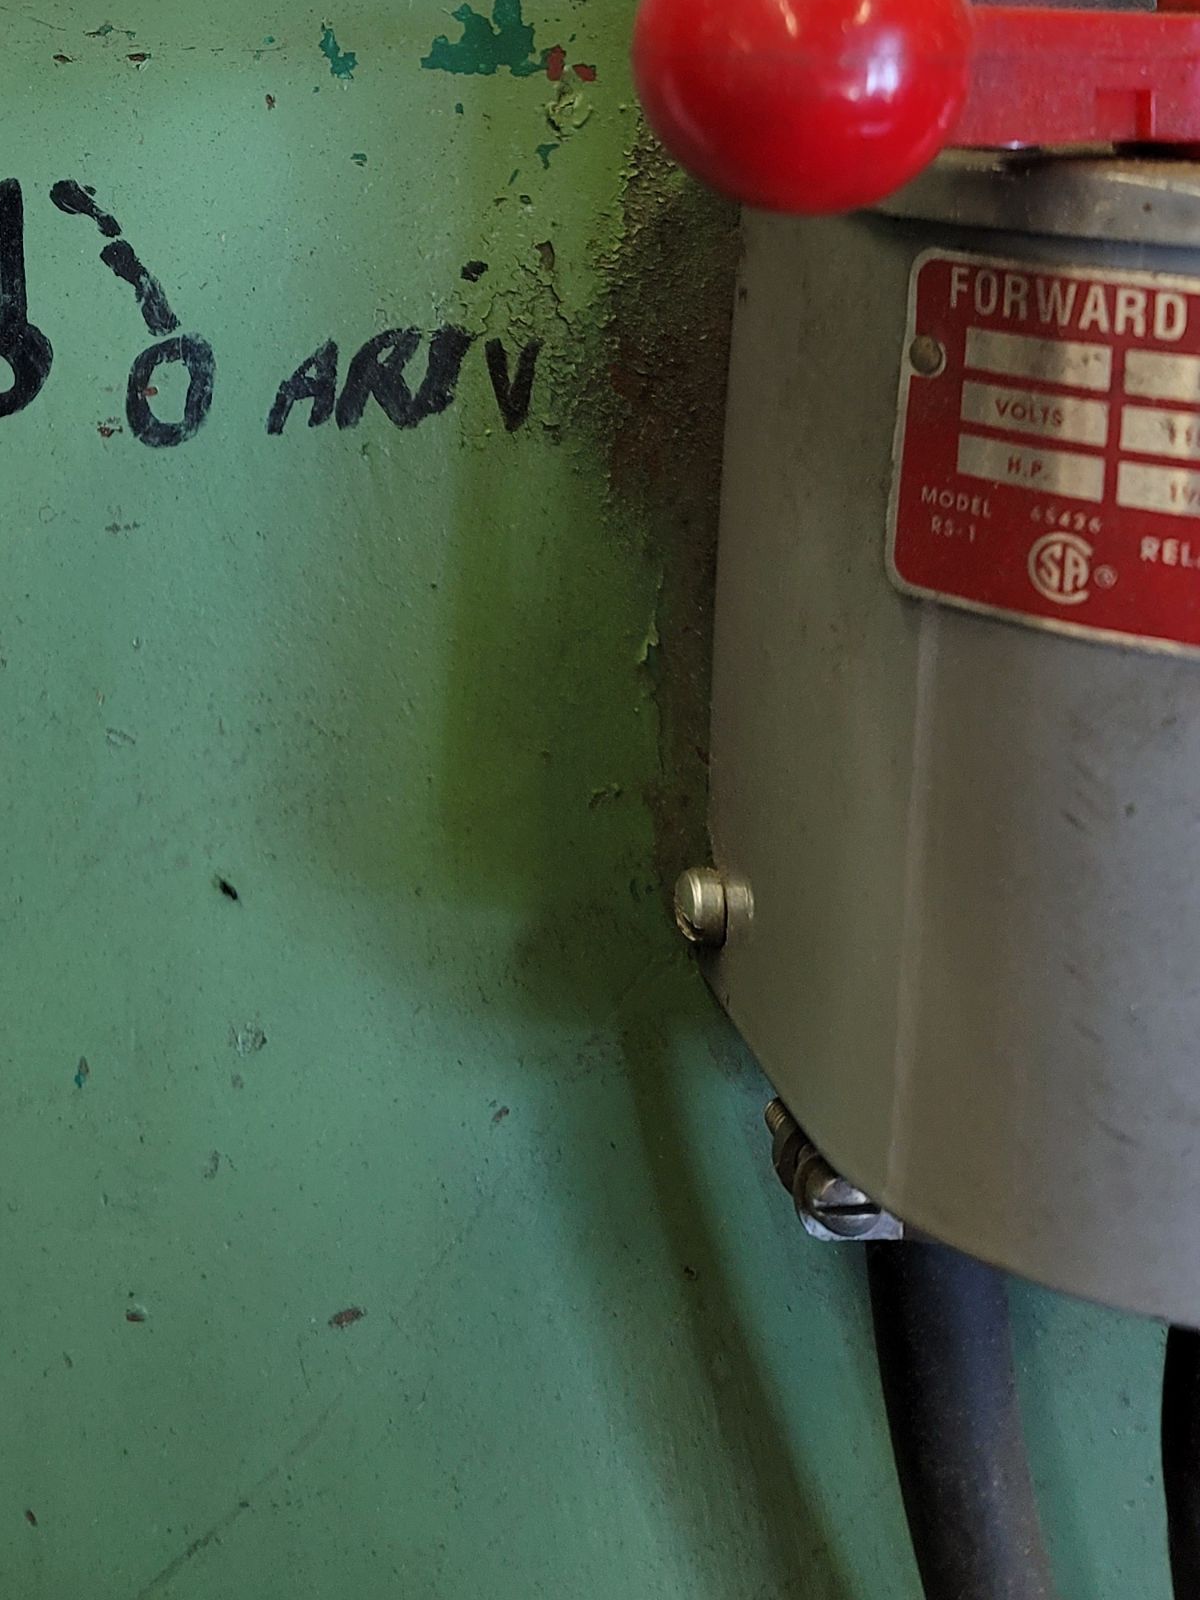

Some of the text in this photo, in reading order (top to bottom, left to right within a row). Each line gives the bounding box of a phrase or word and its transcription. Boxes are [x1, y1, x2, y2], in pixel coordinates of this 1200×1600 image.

[950, 265, 1188, 342] FORWARD
[994, 398, 1065, 429] VOLTS
[1006, 455, 1050, 479] H.P.
[921, 484, 992, 519] MODEL
[930, 514, 977, 543] RS-1
[1140, 535, 1200, 570] REL
